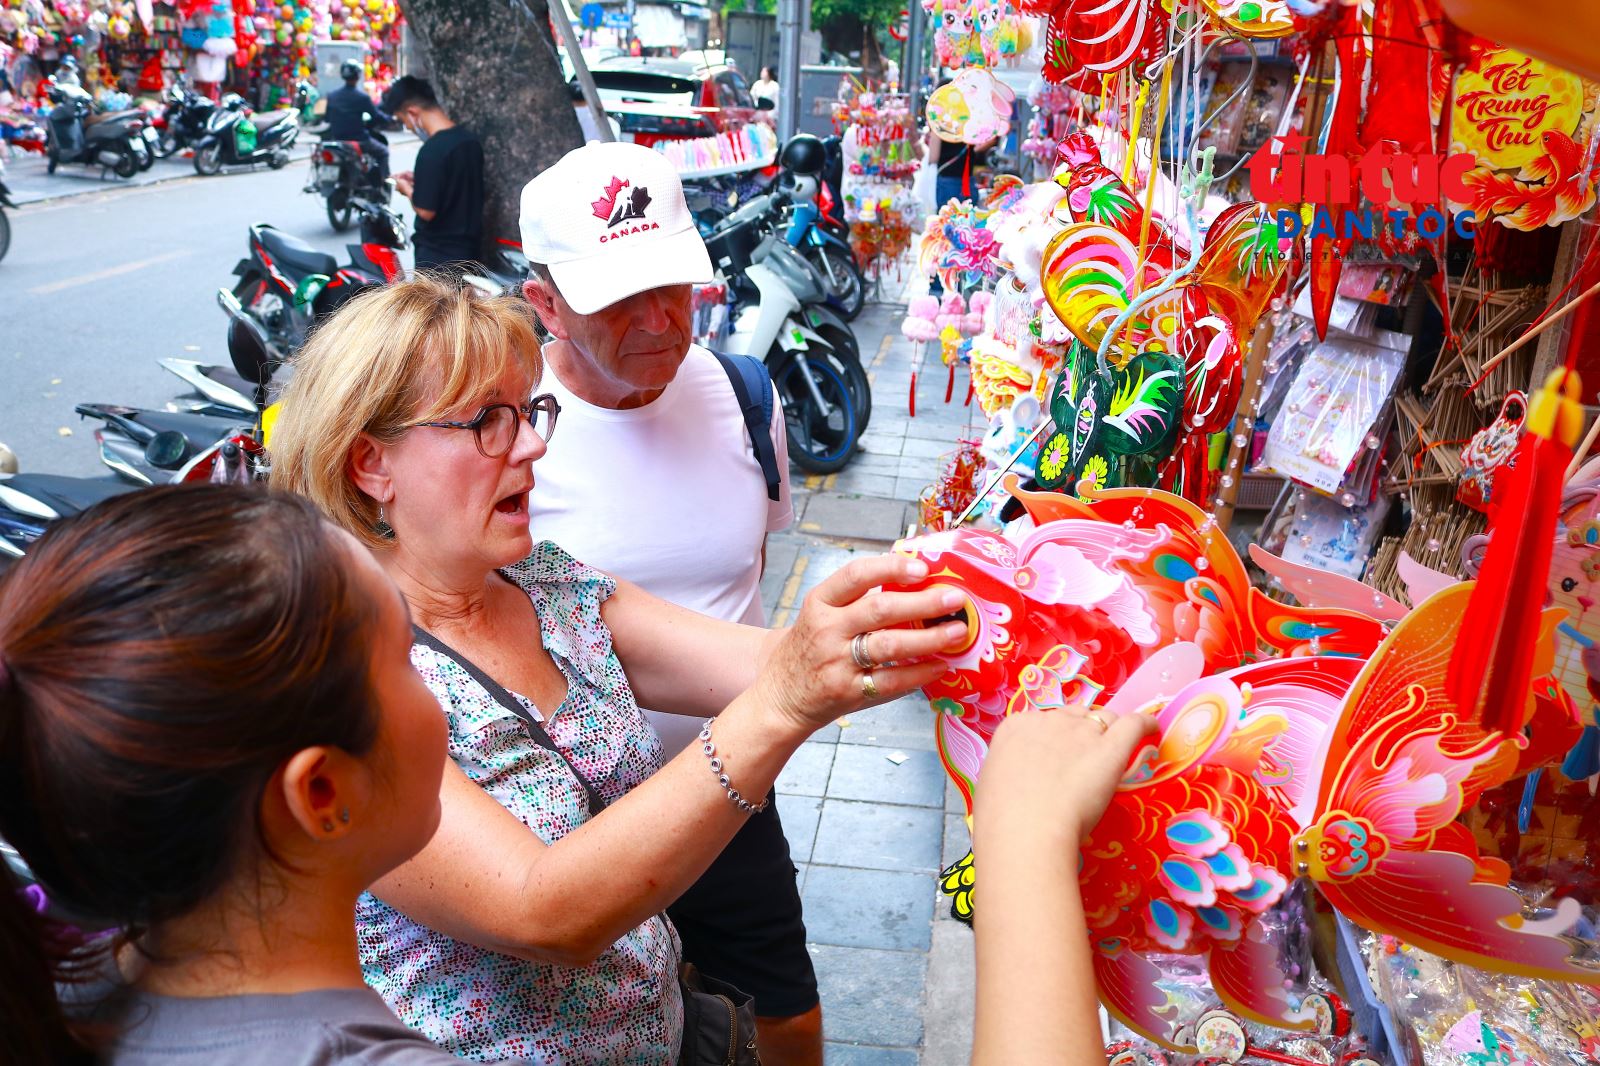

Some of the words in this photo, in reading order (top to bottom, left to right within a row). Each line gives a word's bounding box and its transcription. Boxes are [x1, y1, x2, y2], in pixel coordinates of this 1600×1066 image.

[1483, 57, 1543, 95] Tết
[1456, 90, 1562, 130] Trung
[1476, 116, 1540, 152] Thu
[599, 221, 660, 243] CANADA
